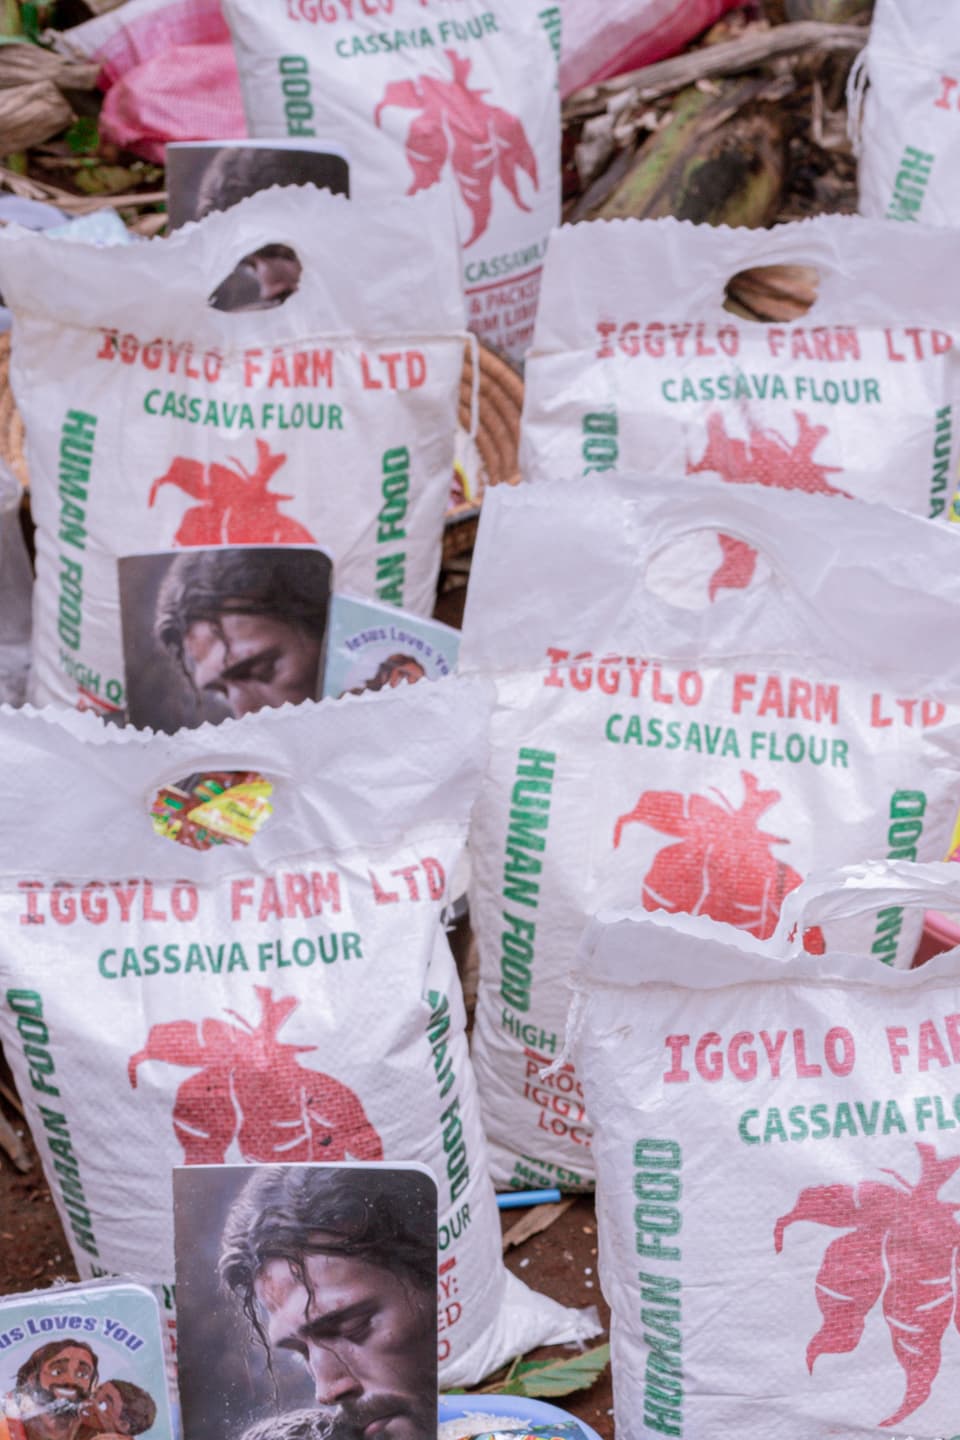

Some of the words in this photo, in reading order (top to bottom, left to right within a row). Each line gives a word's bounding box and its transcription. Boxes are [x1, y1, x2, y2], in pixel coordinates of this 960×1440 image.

[279, 55, 315, 136] FOOD
[244, 349, 333, 387] FARM
[361, 351, 426, 390] LTD
[596, 321, 738, 358] IGGYLO
[768, 327, 860, 361] FARM
[885, 328, 953, 361] LTD
[144, 389, 254, 429] CASSAVA
[262, 403, 343, 429] FLOUR
[662, 373, 787, 402] CASSAVA
[795, 376, 880, 404] FLOUR
[60, 410, 96, 547] HUMAN
[378, 448, 409, 543] FOOD
[59, 555, 83, 650] FOOD
[544, 648, 702, 706] IGGYLO
[732, 673, 838, 724] FARM
[871, 694, 945, 727] LTD
[605, 714, 739, 758] CASSAVA
[751, 731, 848, 767] FLOUR
[504, 748, 555, 906] HUMAN
[18, 880, 198, 925] IGGYLO
[232, 872, 340, 921] FARM
[372, 858, 445, 903] LTD
[98, 943, 248, 978] CASSAVA
[258, 932, 362, 971] FLOUR
[501, 912, 535, 1011] FOOD
[5, 988, 59, 1095] FOOD
[501, 1004, 557, 1055] HIGH
[664, 1027, 855, 1082] IGGYLO
[739, 1100, 906, 1143] CASSAVA
[36, 1102, 103, 1260] HUMAN
[633, 1139, 681, 1260] FOOD
[26, 1315, 97, 1338] Loves
[102, 1317, 145, 1352] You
[640, 1274, 683, 1437] HUMAN
